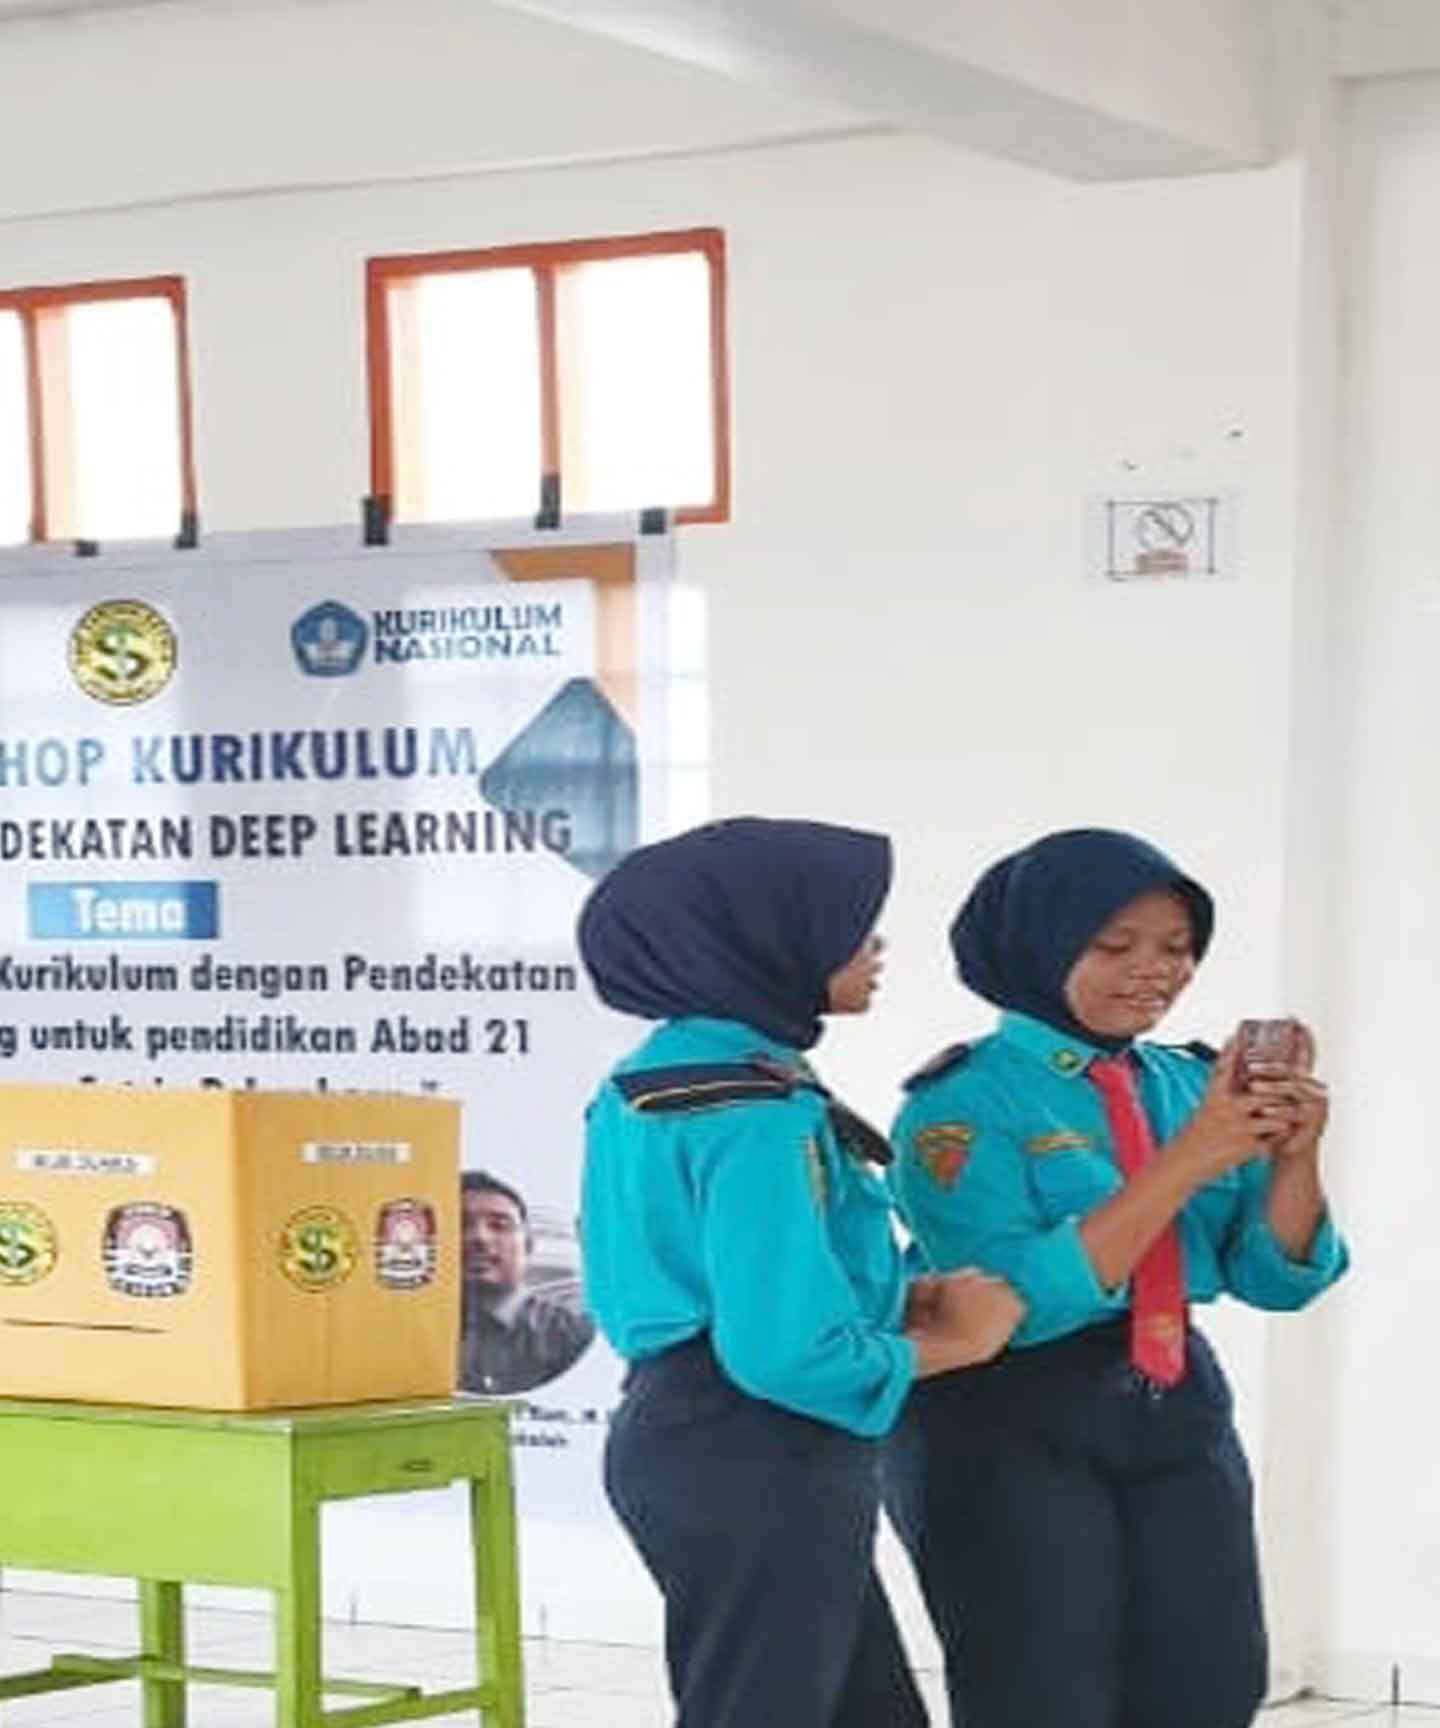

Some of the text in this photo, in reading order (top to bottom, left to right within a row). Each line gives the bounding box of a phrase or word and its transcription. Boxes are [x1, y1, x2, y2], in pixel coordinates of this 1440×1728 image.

[373, 604, 563, 636] KURIKULUM
[374, 632, 561, 664] NASIONAL
[133, 726, 478, 785] KURIKULUM
[210, 813, 317, 859] DEEP
[335, 810, 572, 858] LEARNING
[70, 886, 185, 933] Tema
[191, 955, 328, 998] dengan
[343, 954, 577, 992] Pendekatan
[30, 1015, 133, 1051] untuk
[146, 1015, 356, 1059] pendidikan
[370, 1017, 469, 1054] Abad
[485, 1019, 530, 1055] 21
